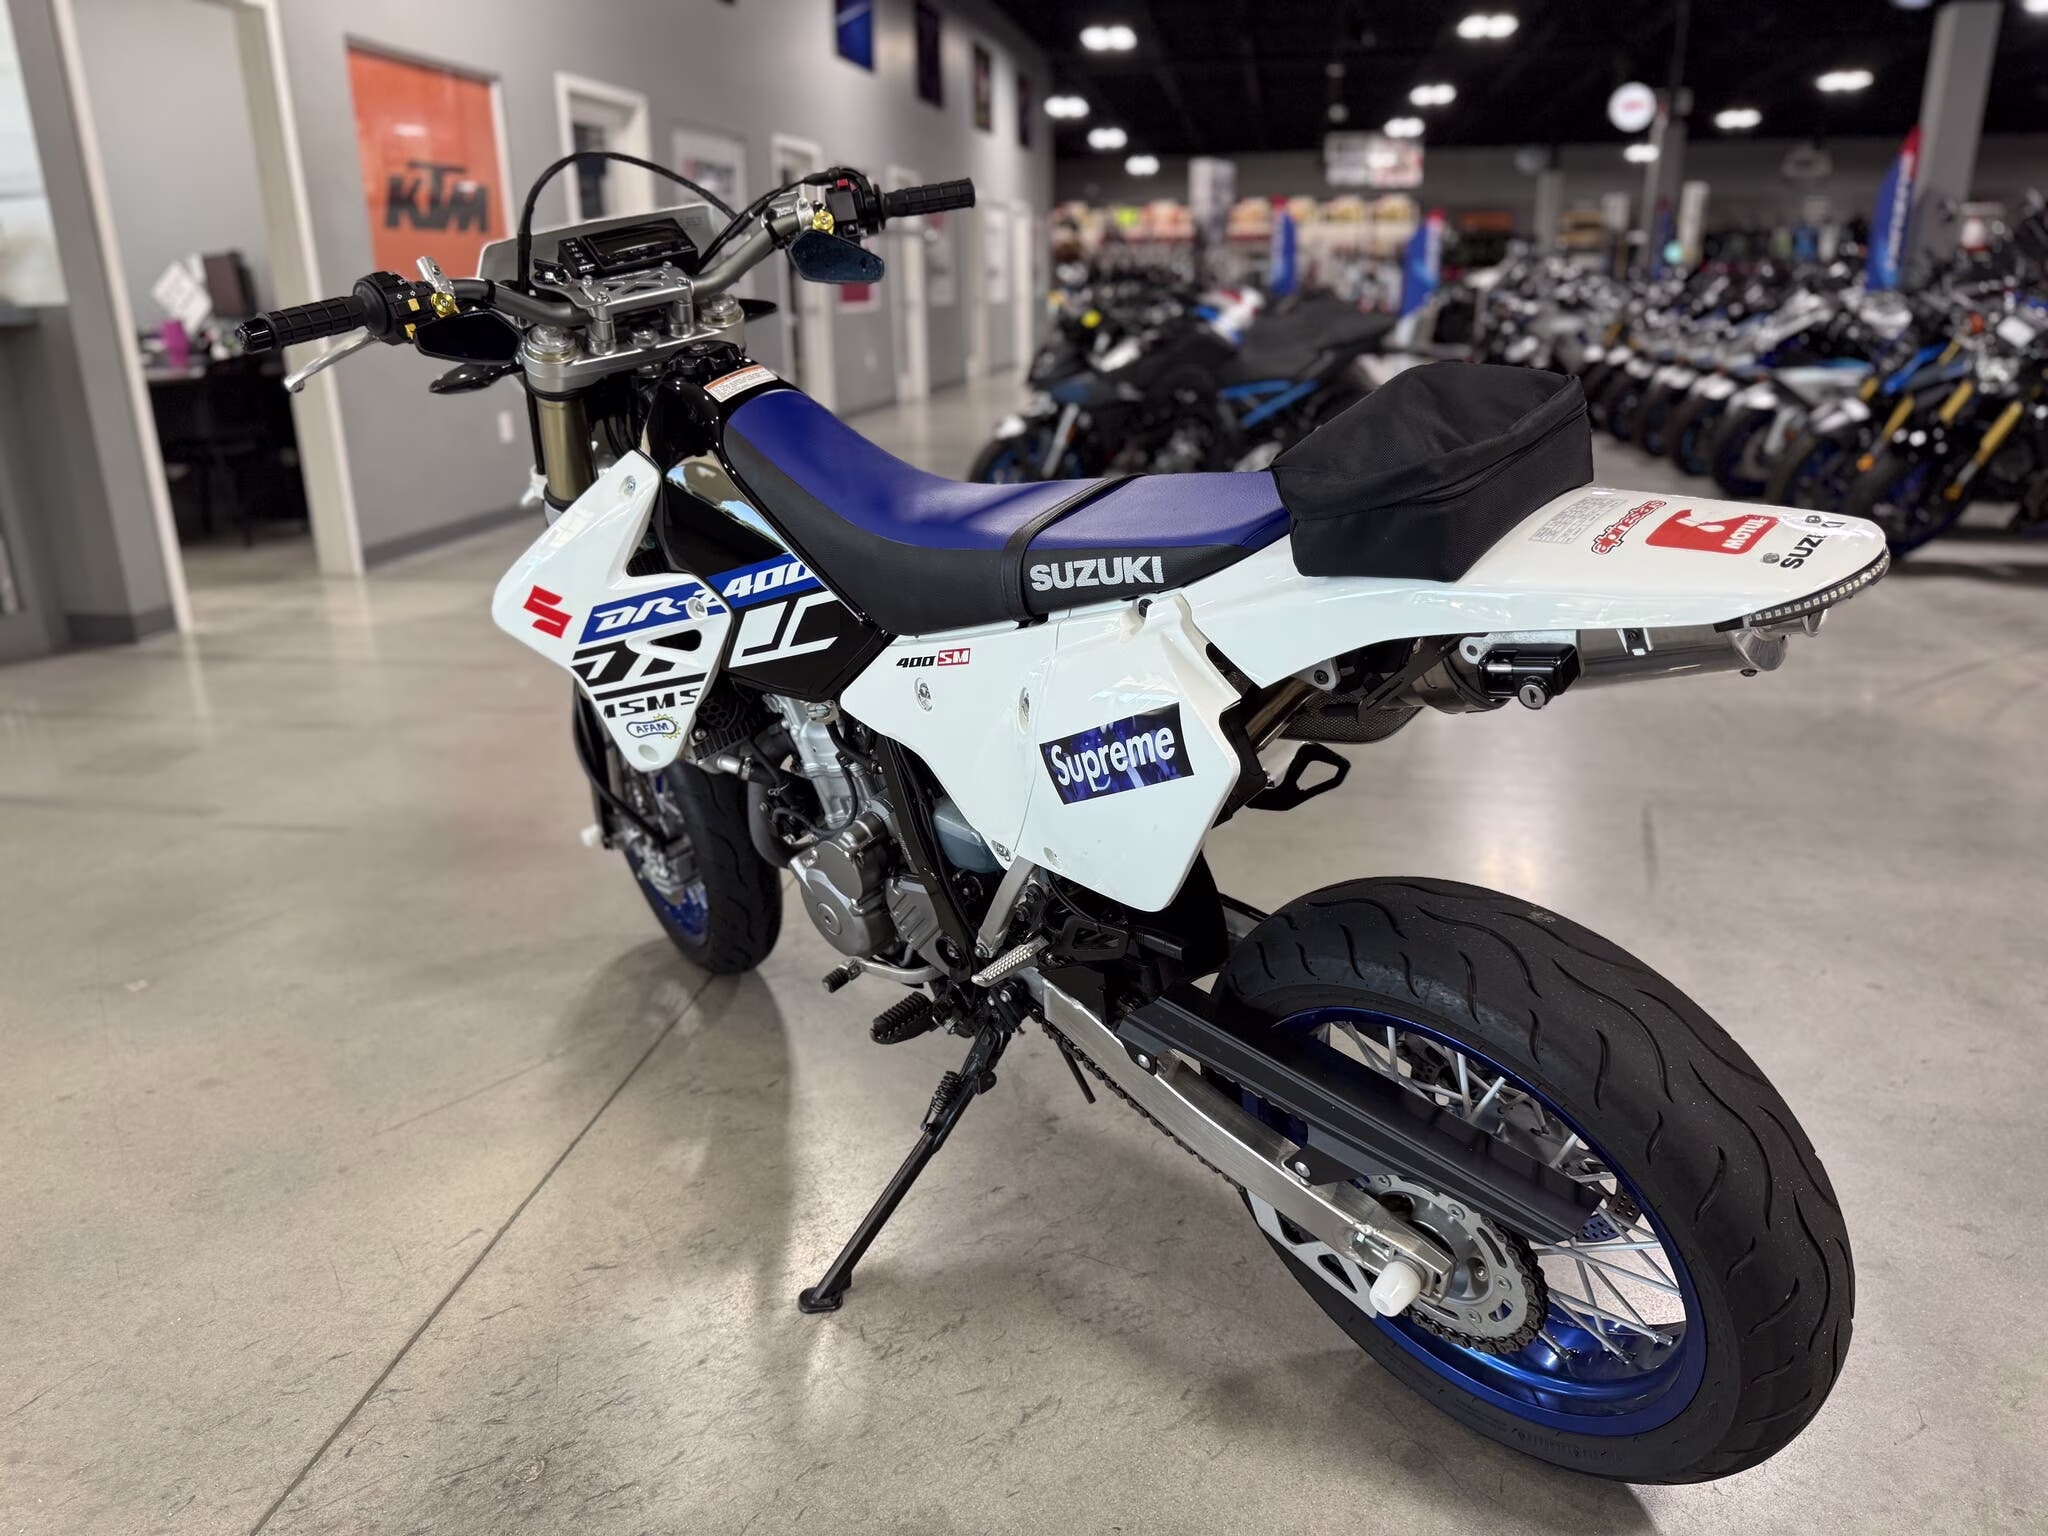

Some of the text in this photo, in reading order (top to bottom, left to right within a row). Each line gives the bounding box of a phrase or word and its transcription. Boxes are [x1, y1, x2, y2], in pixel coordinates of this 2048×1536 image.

[385, 161, 488, 234] KTM
[1029, 556, 1165, 592] SUZUKI
[635, 723, 670, 734] AFAM
[1050, 727, 1176, 793] Supreme
